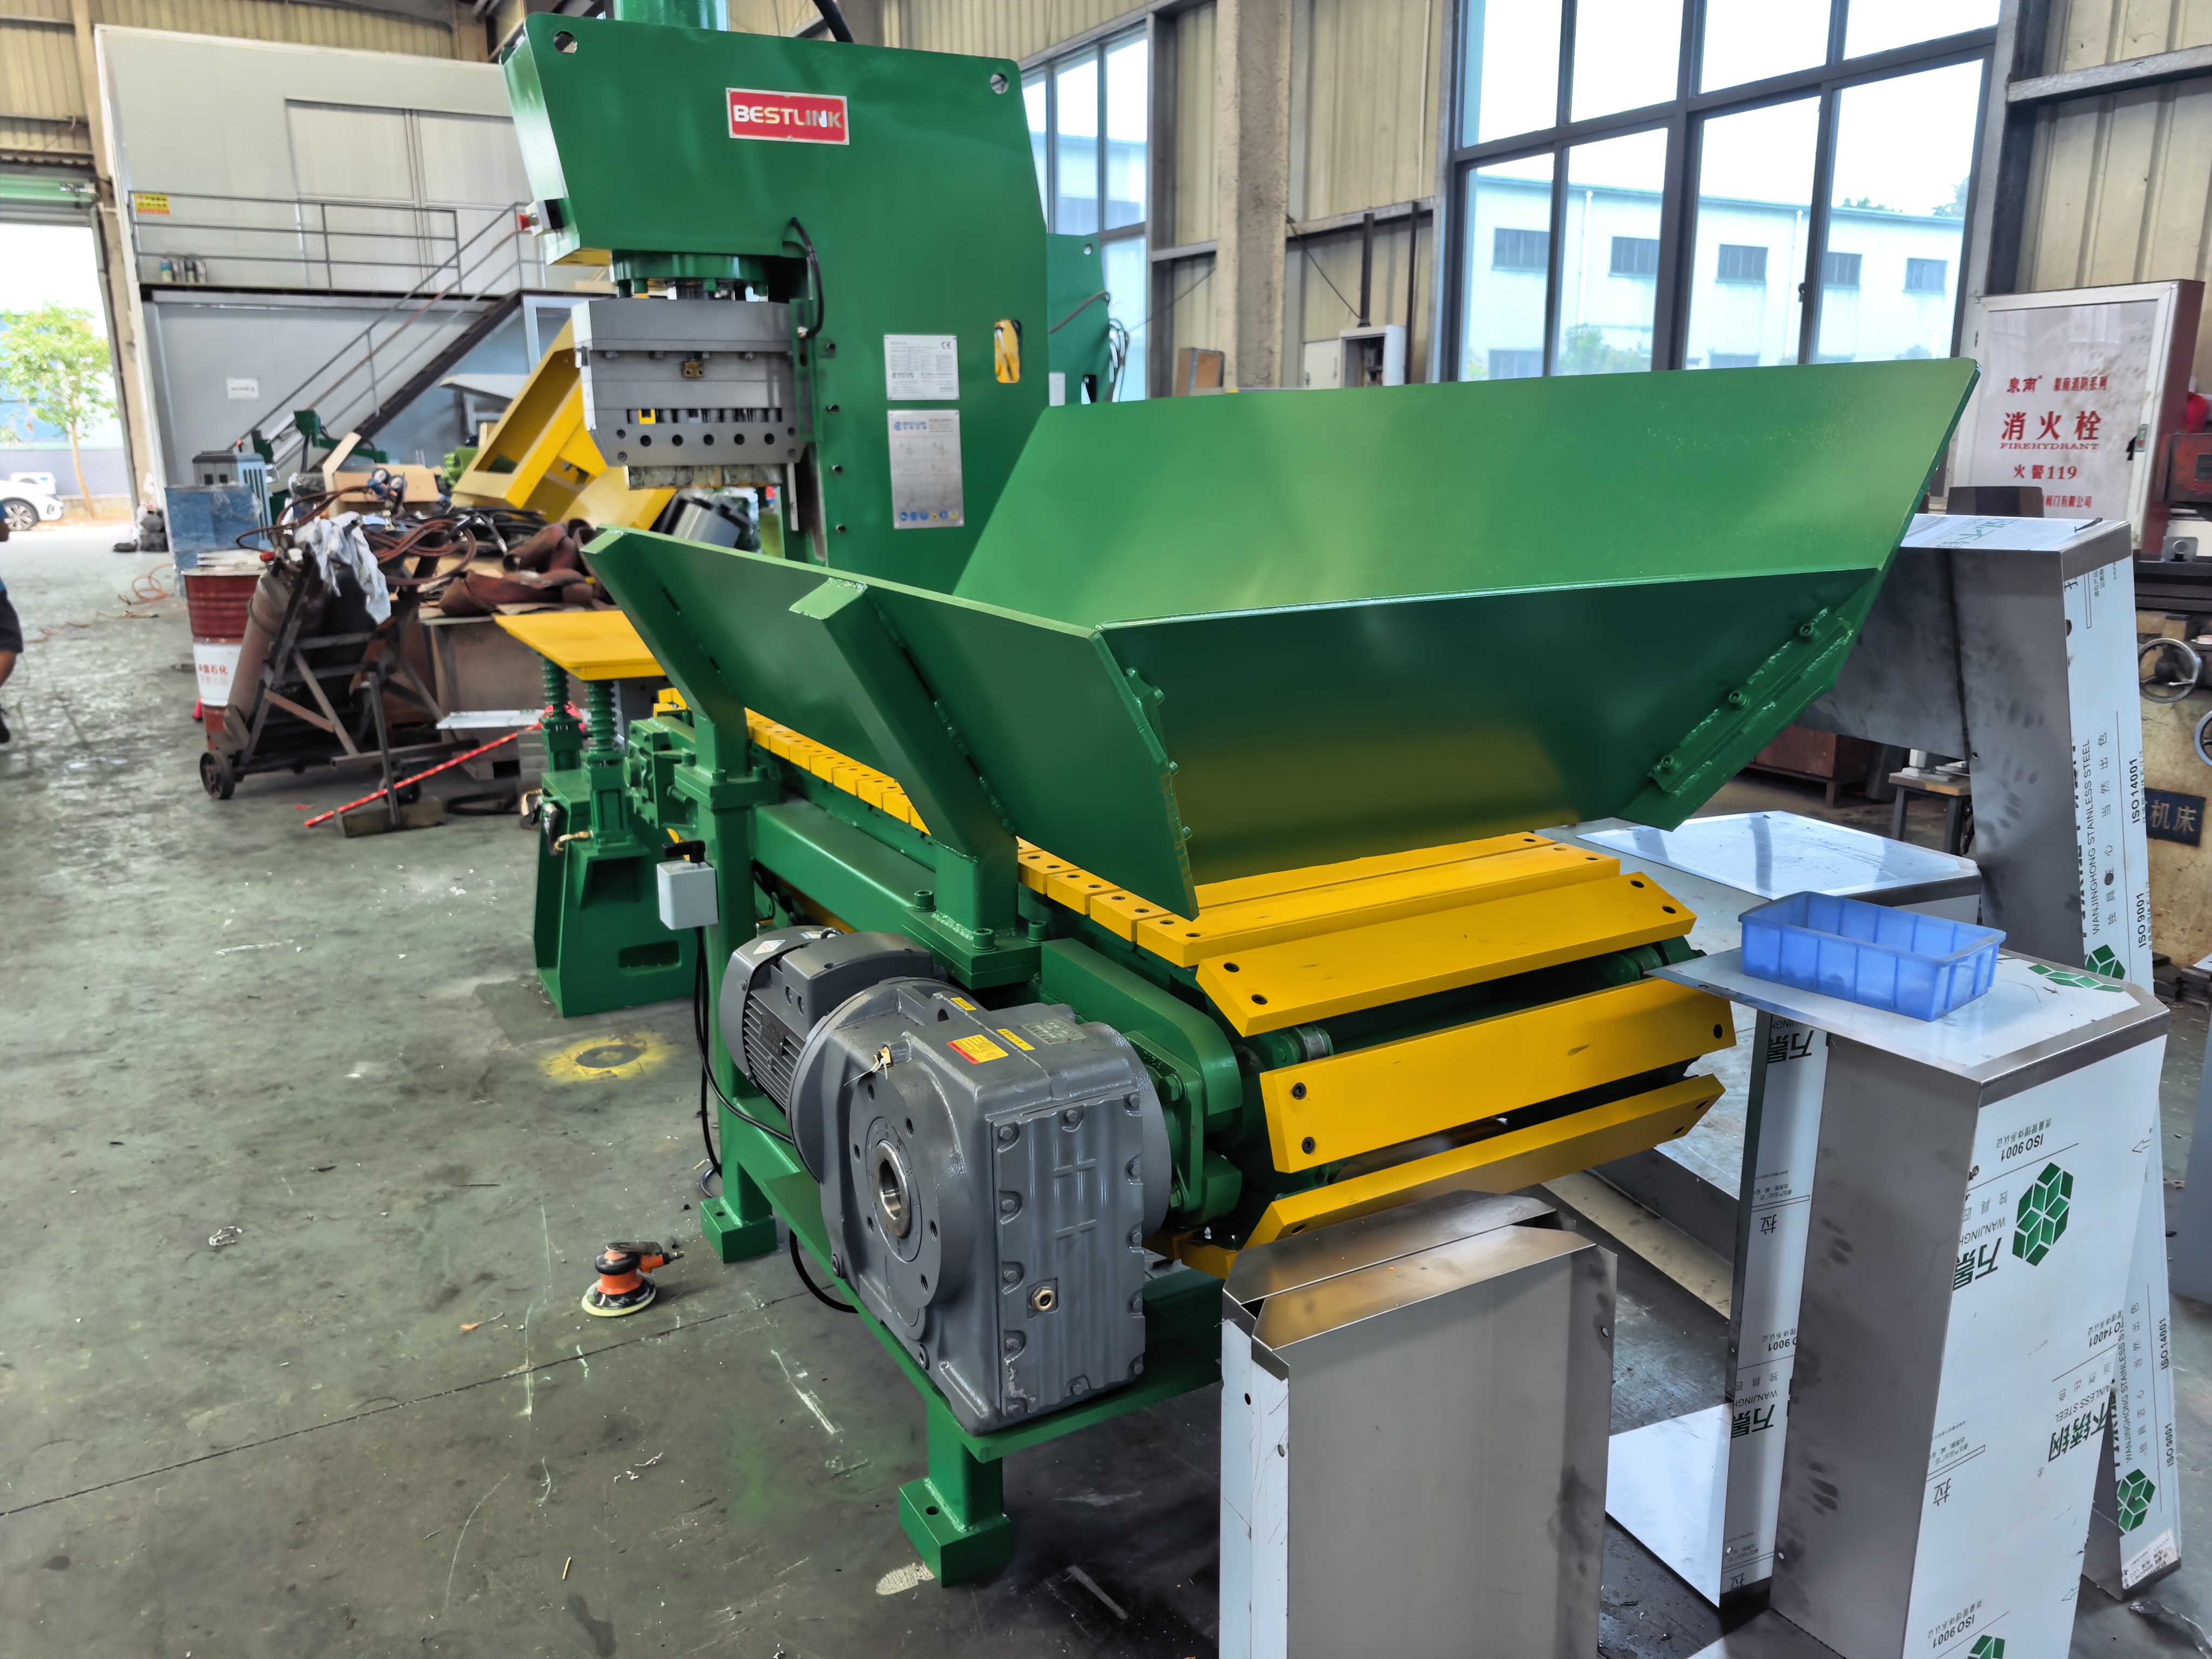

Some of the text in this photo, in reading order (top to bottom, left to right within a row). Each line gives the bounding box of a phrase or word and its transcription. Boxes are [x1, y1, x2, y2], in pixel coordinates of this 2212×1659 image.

[733, 105, 842, 128] BESTLINK
[2001, 411, 2102, 441] 消火栓
[2044, 495, 2092, 509] 阀门有限公司
[2129, 758, 2140, 824] ISO 14001
[2150, 799, 2197, 834] 机床
[2082, 739, 2100, 935] WANJINGHONG STAINLESS STEEL
[2136, 893, 2147, 948] ISO 9001
[1767, 1030, 1814, 1064] 万景
[2001, 1133, 2044, 1162] ISO 9001
[1760, 1214, 1777, 1235] 拉
[1953, 1237, 2002, 1291] 万景
[1768, 1338, 1791, 1352] 9001
[2089, 1325, 2112, 1348] 14001
[2159, 1318, 2169, 1371] ISO 14001
[2117, 1343, 2129, 1393] STAINLESS
[1731, 1404, 1776, 1439] 万景
[2055, 1401, 2079, 1423] STEEL
[2122, 1393, 2133, 1464] WANJINGHONG
[2048, 1402, 2107, 1462] 不锈钢
[2164, 1422, 2175, 1468] ISO 9001
[1933, 1478, 1951, 1506] 拉
[1932, 1613, 1975, 1649] ISO 9001
